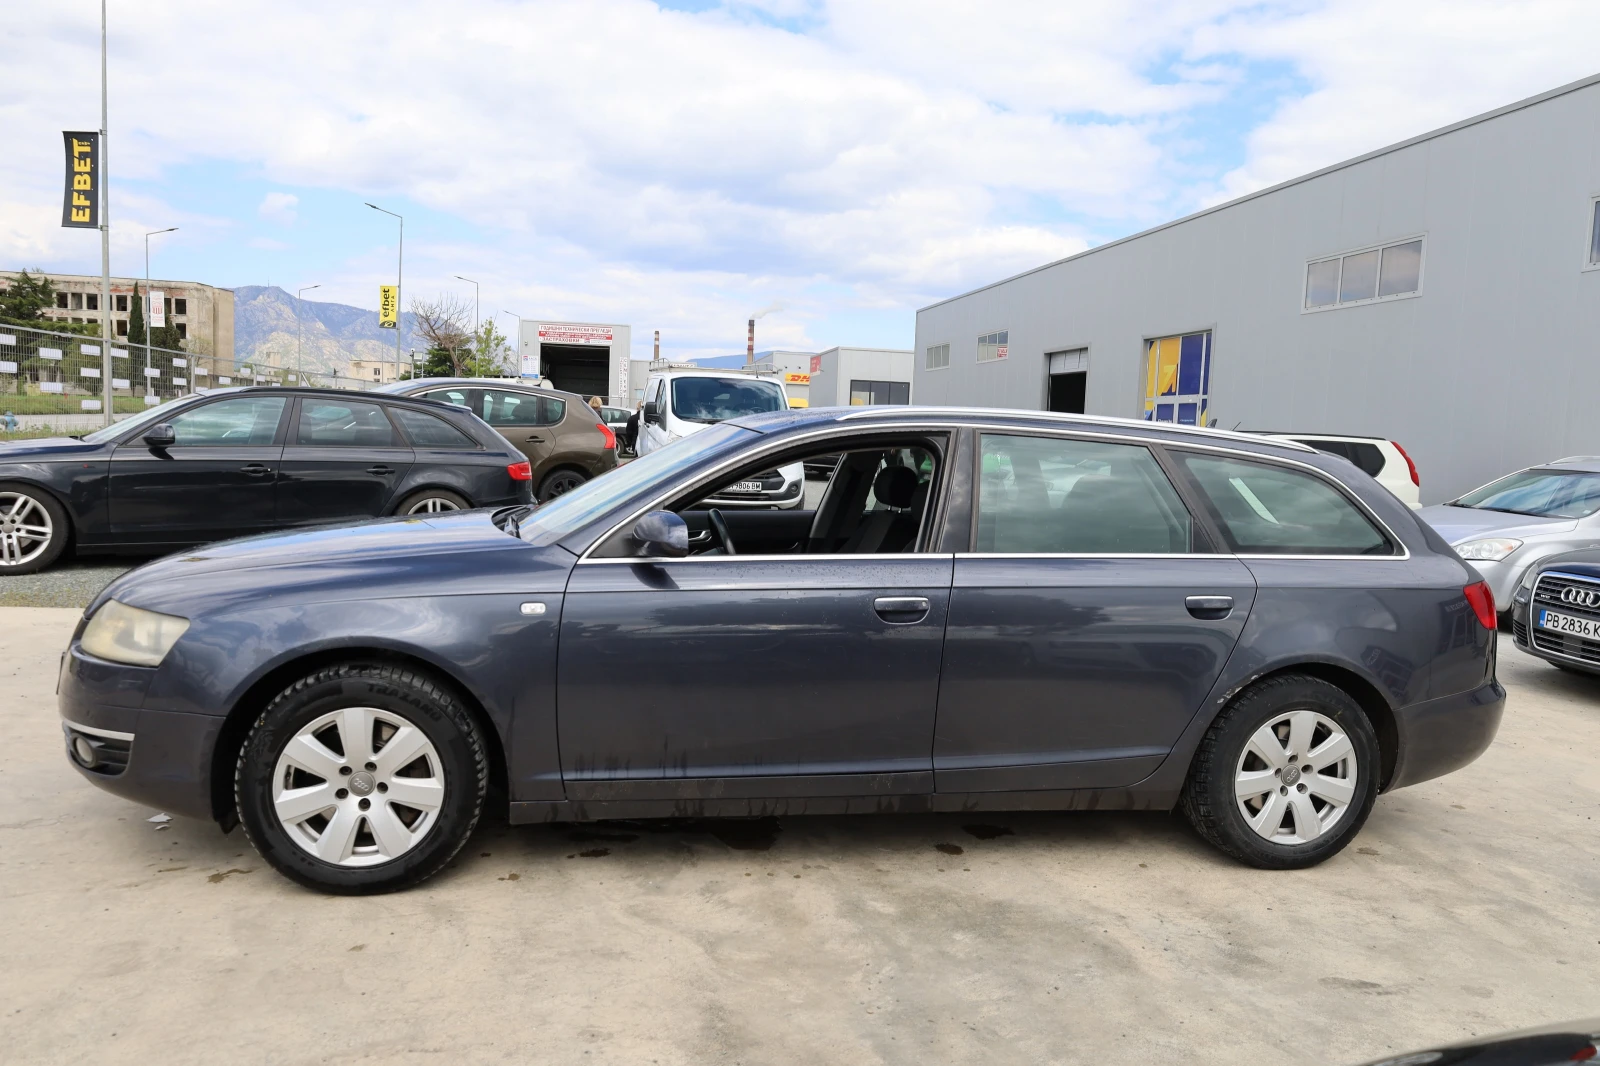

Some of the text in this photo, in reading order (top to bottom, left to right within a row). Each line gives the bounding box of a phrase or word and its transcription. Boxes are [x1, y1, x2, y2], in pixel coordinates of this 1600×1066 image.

[71, 138, 91, 222] EFBET
[382, 288, 390, 318] efbet
[790, 374, 810, 382] DH
[1545, 613, 1560, 628] PB
[1561, 617, 1591, 636] 2836
[367, 683, 442, 721] TRAZANO
